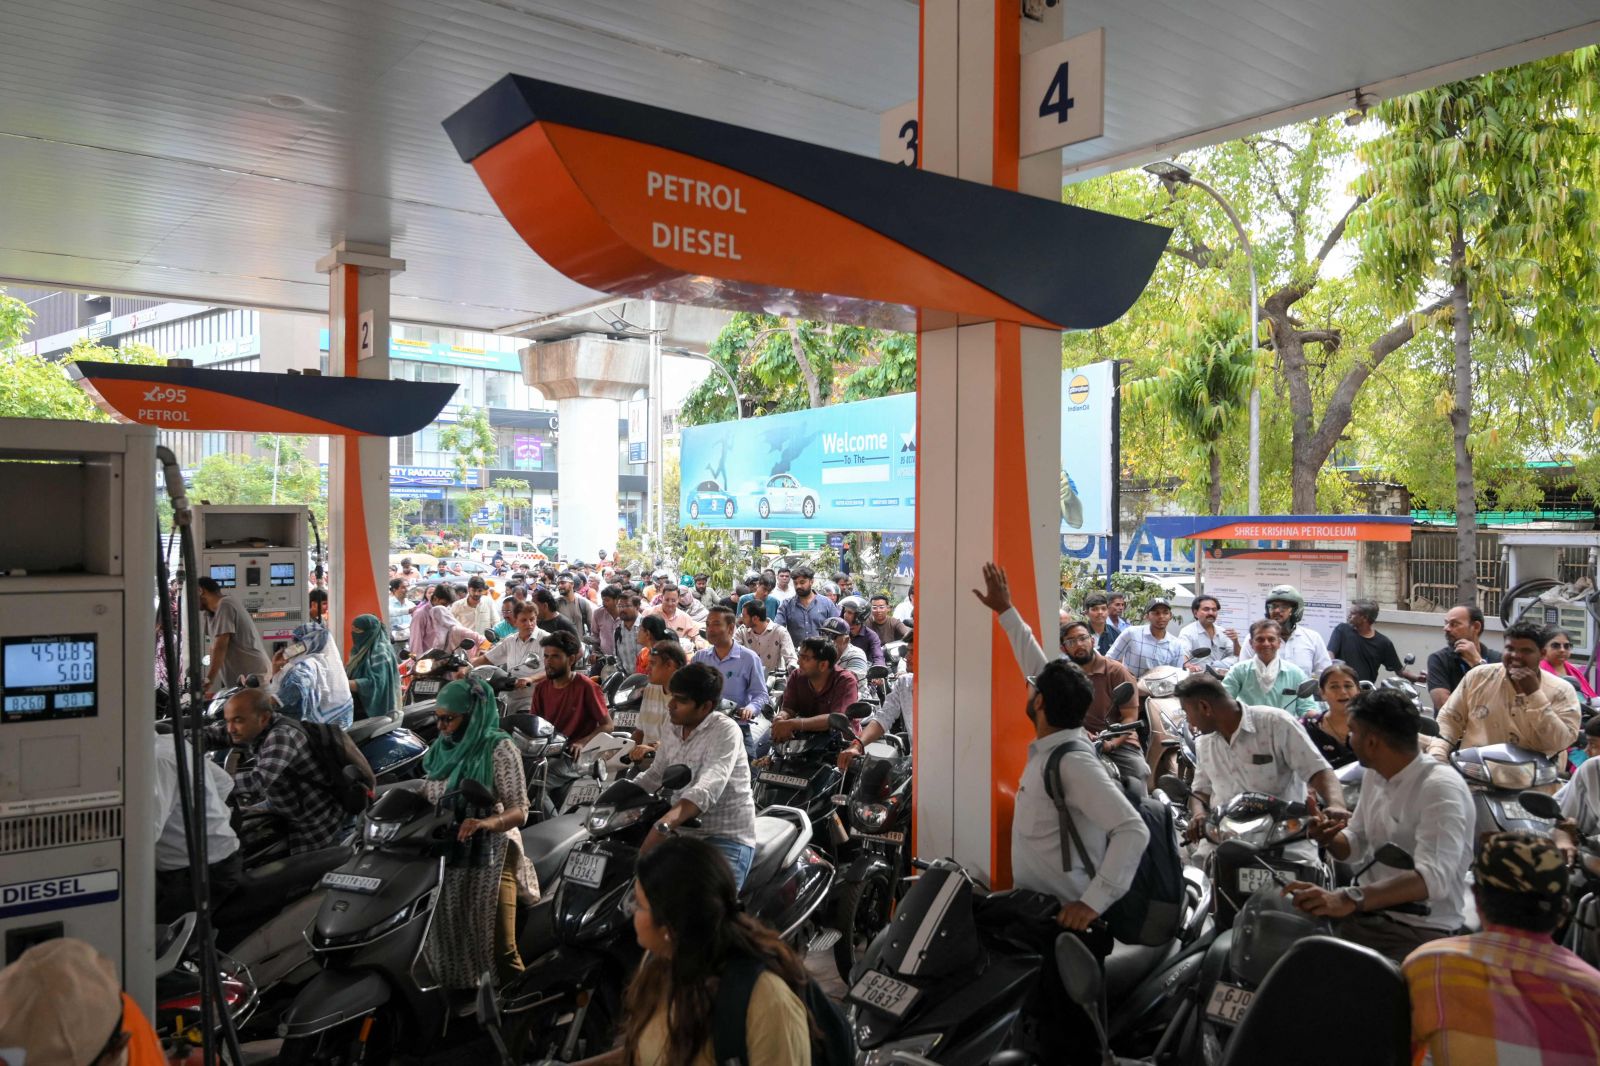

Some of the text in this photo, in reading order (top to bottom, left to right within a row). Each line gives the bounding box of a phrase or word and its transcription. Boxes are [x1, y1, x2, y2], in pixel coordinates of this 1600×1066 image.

[1039, 60, 1074, 124] 4
[898, 119, 918, 169] 3
[648, 170, 747, 214] PETROL
[652, 221, 742, 260] DIESEL
[362, 321, 369, 349] 2
[138, 408, 191, 422] PETROL
[822, 431, 888, 455] Welcome
[844, 454, 865, 464] To The
[408, 468, 455, 477] RADIOLOGY
[1234, 526, 1356, 537] SHREE KRISHNA PETROLEUM
[31, 643, 93, 662] 450.85
[58, 662, 92, 682] 5.00
[3, 879, 86, 904] DIESEL
